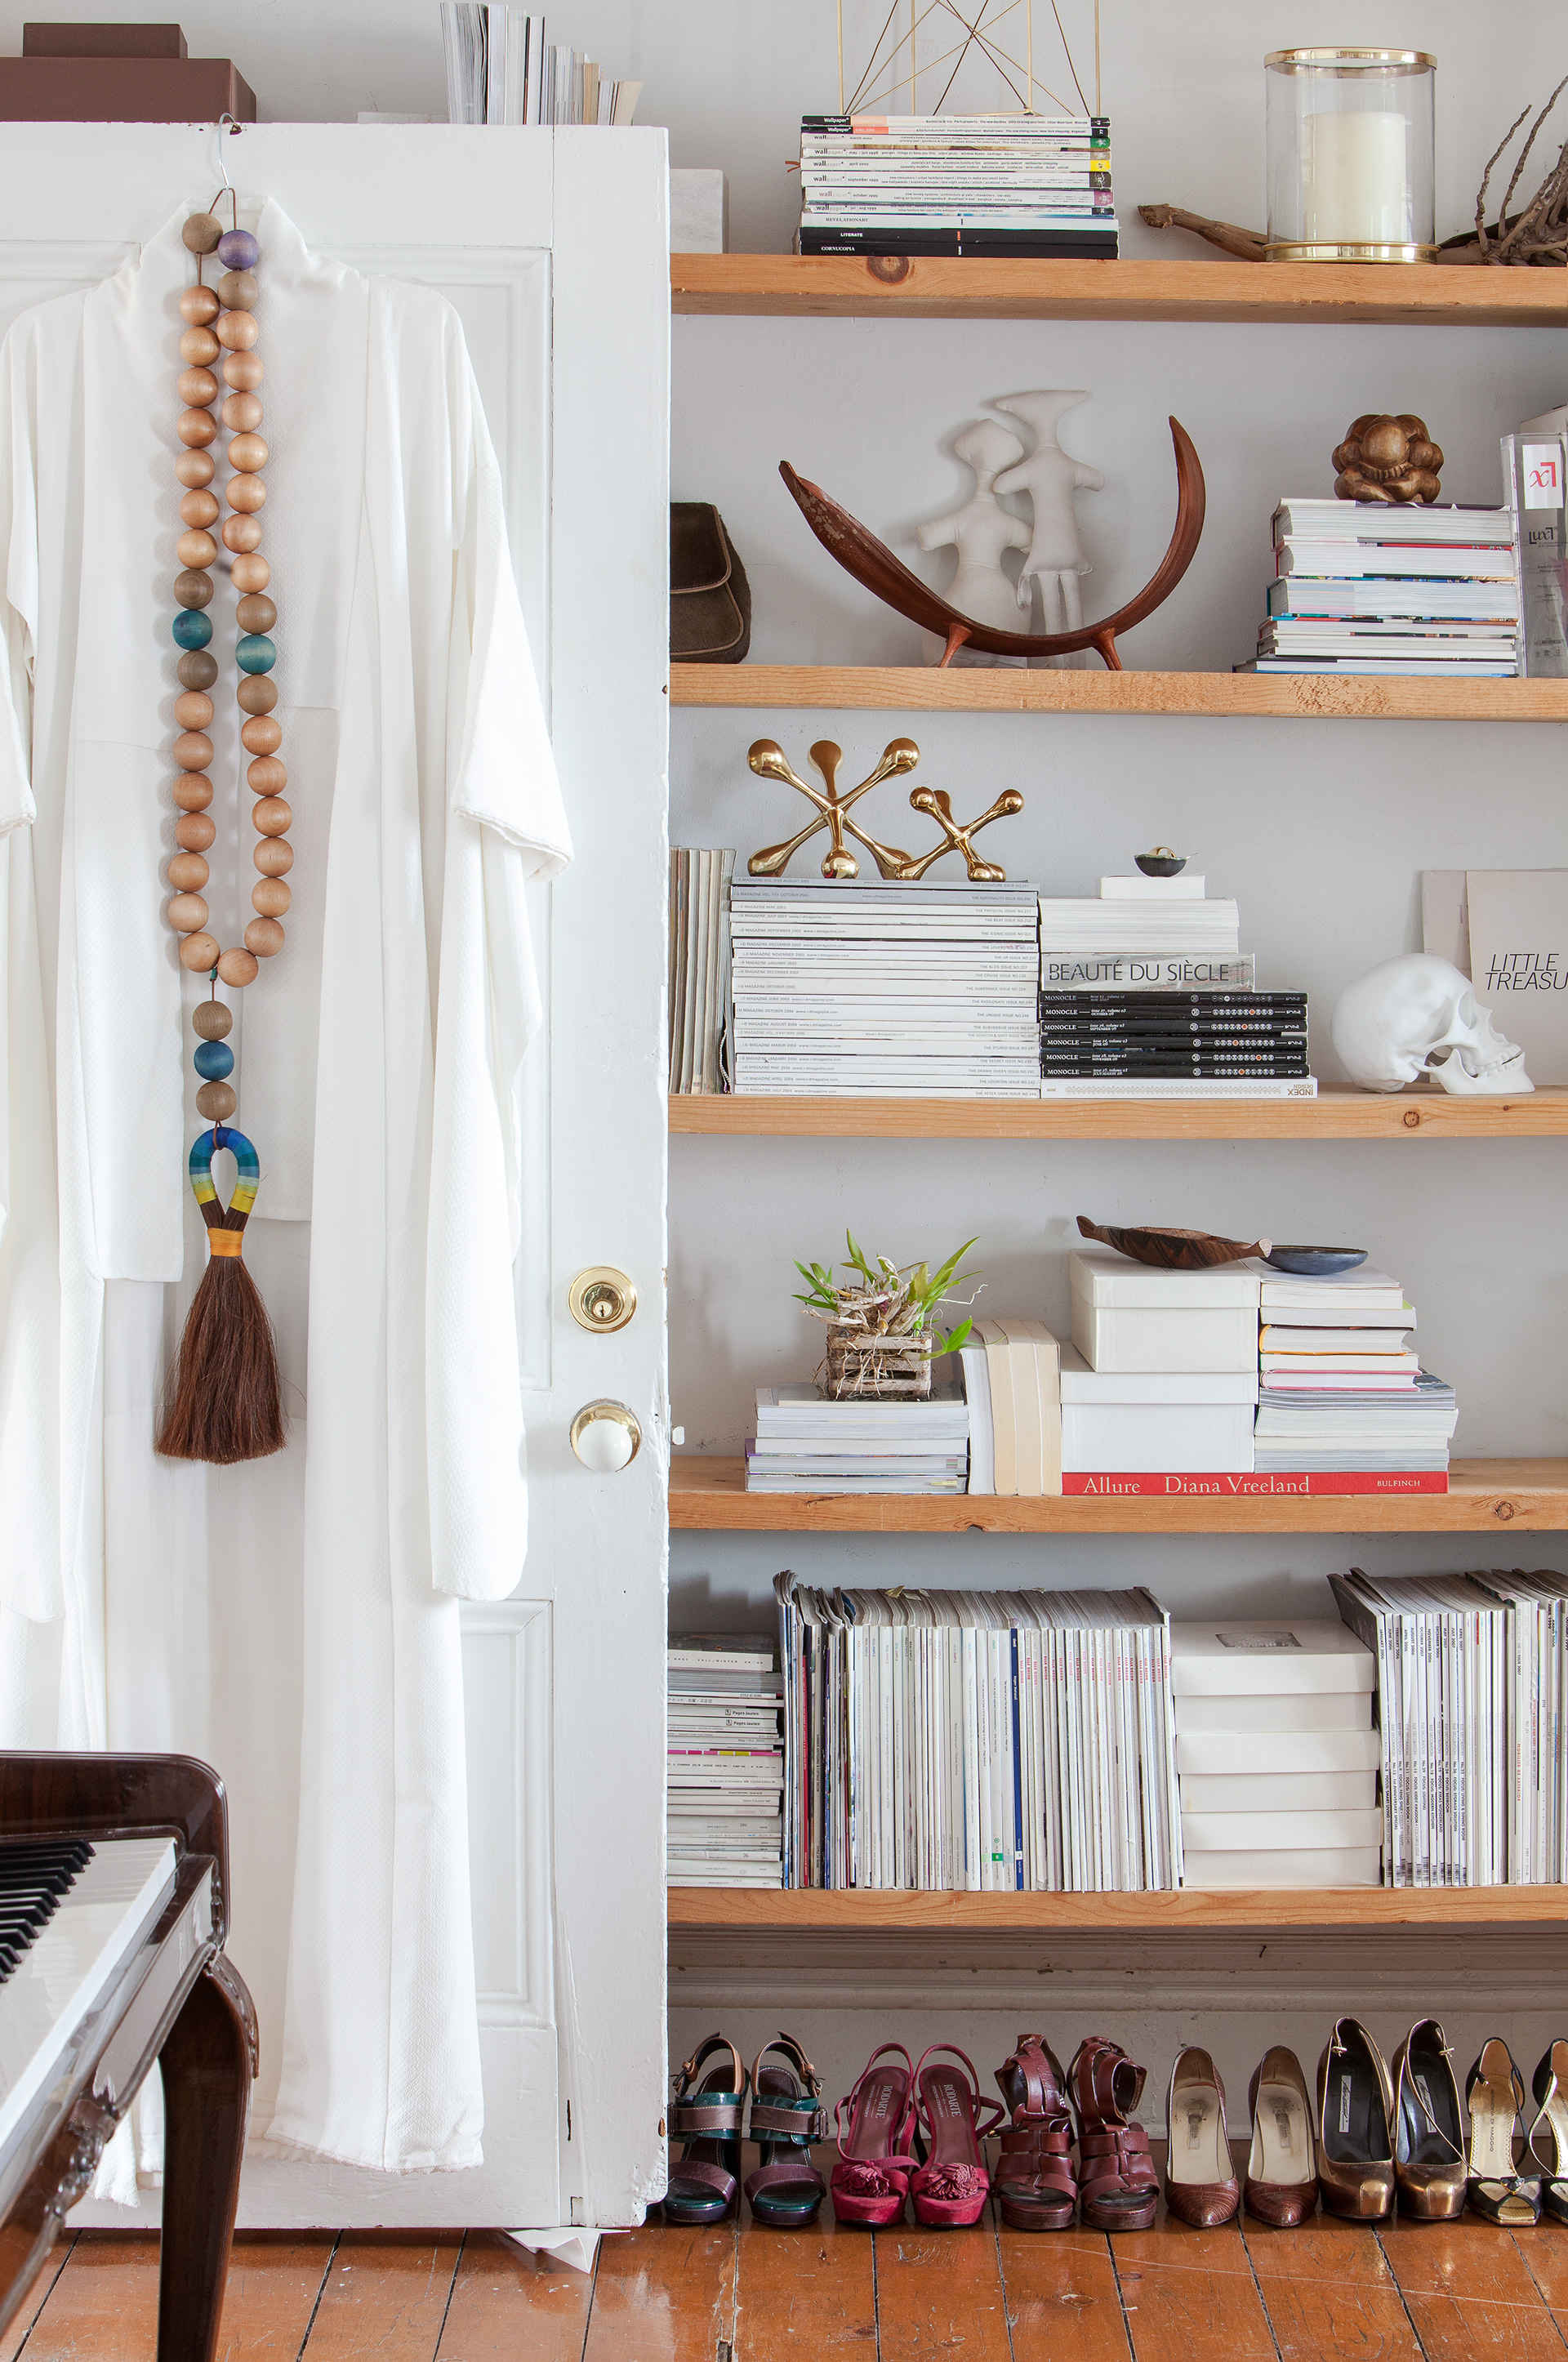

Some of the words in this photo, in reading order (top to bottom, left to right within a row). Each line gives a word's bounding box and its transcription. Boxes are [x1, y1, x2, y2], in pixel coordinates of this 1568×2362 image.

[1049, 960, 1122, 981] BEAUTÉ
[1130, 964, 1160, 981] DU
[1167, 960, 1229, 982] SIÈCLE
[1491, 953, 1559, 972] LITTLE
[1085, 1476, 1140, 1494] Allure
[1165, 1476, 1220, 1494] Diana
[1226, 1476, 1310, 1494] Vreeland
[875, 2085, 893, 2119] RODARTE
[944, 2084, 961, 2117] RODARTE
